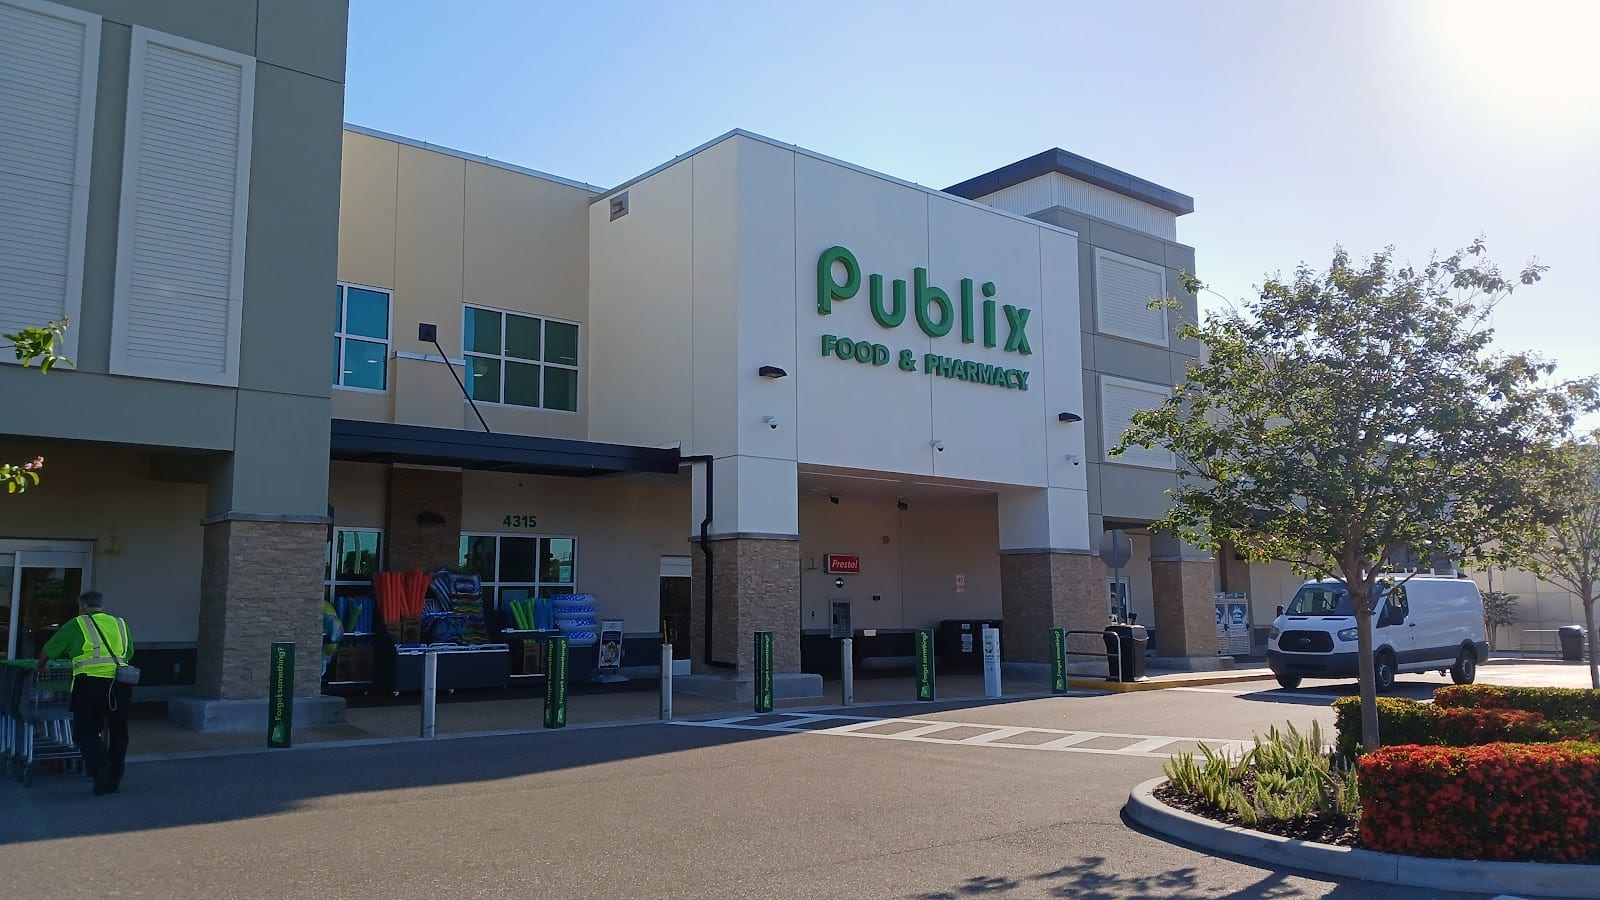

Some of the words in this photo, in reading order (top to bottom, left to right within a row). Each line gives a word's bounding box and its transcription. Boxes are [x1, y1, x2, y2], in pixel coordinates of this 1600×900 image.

[817, 245, 1032, 355] Publix
[821, 334, 890, 366] FOOD
[899, 349, 917, 371] &
[924, 353, 1030, 391] PHARMACY
[503, 515, 537, 528] 4315
[831, 559, 859, 569] Presto!
[277, 646, 286, 693] something?
[275, 694, 285, 721] Forget
